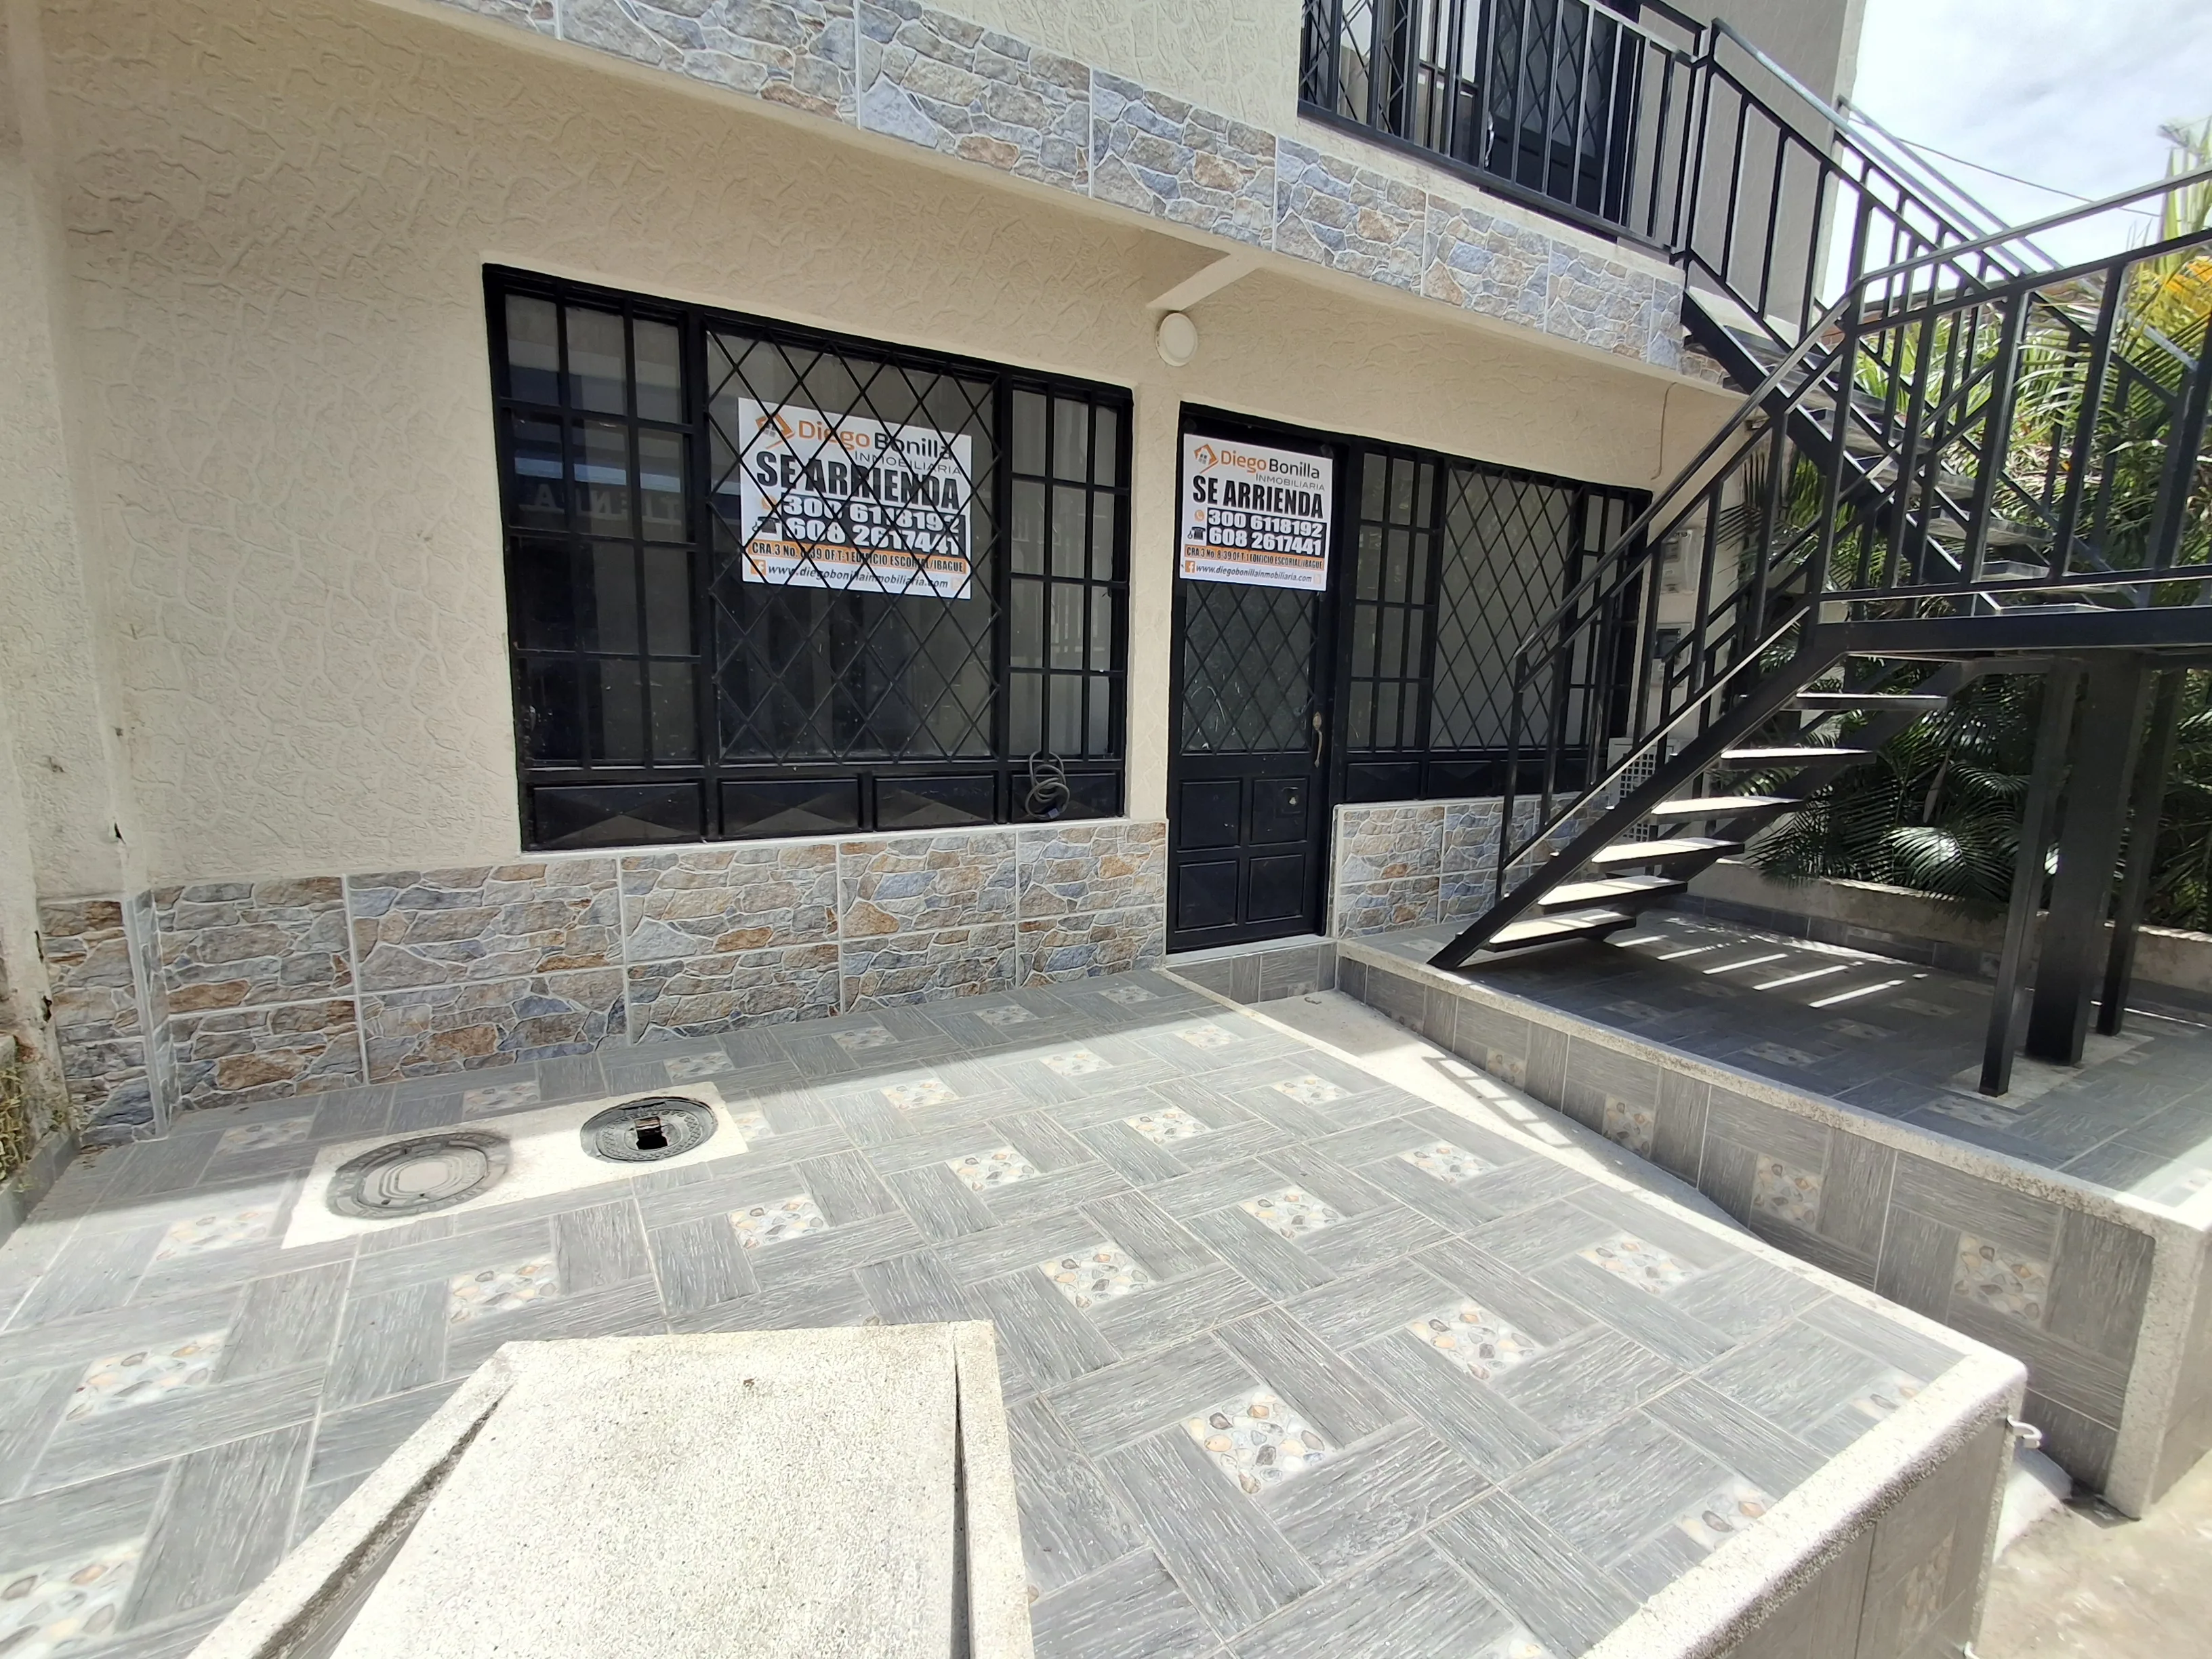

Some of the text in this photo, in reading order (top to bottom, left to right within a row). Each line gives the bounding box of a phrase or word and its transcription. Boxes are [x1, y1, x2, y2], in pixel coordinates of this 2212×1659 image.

[798, 419, 953, 461] Diego Bonilla
[855, 451, 962, 476] INMOBILIARIA
[1221, 450, 1320, 480] Diego Bonilla
[756, 450, 960, 510] SE ARRIENDA
[1255, 473, 1326, 491] INMOBILIARIA
[1192, 474, 1324, 519] SE ARRIENDA
[783, 495, 960, 535] 300 6118192
[1208, 509, 1322, 538] 300 6118192
[786, 516, 960, 556] 608 2617441
[1208, 527, 1322, 556] 608 2617441
[1250, 553, 1273, 565] EDIFICIO
[1195, 565, 1313, 583] www.diegobonillainmobiliaria.com
